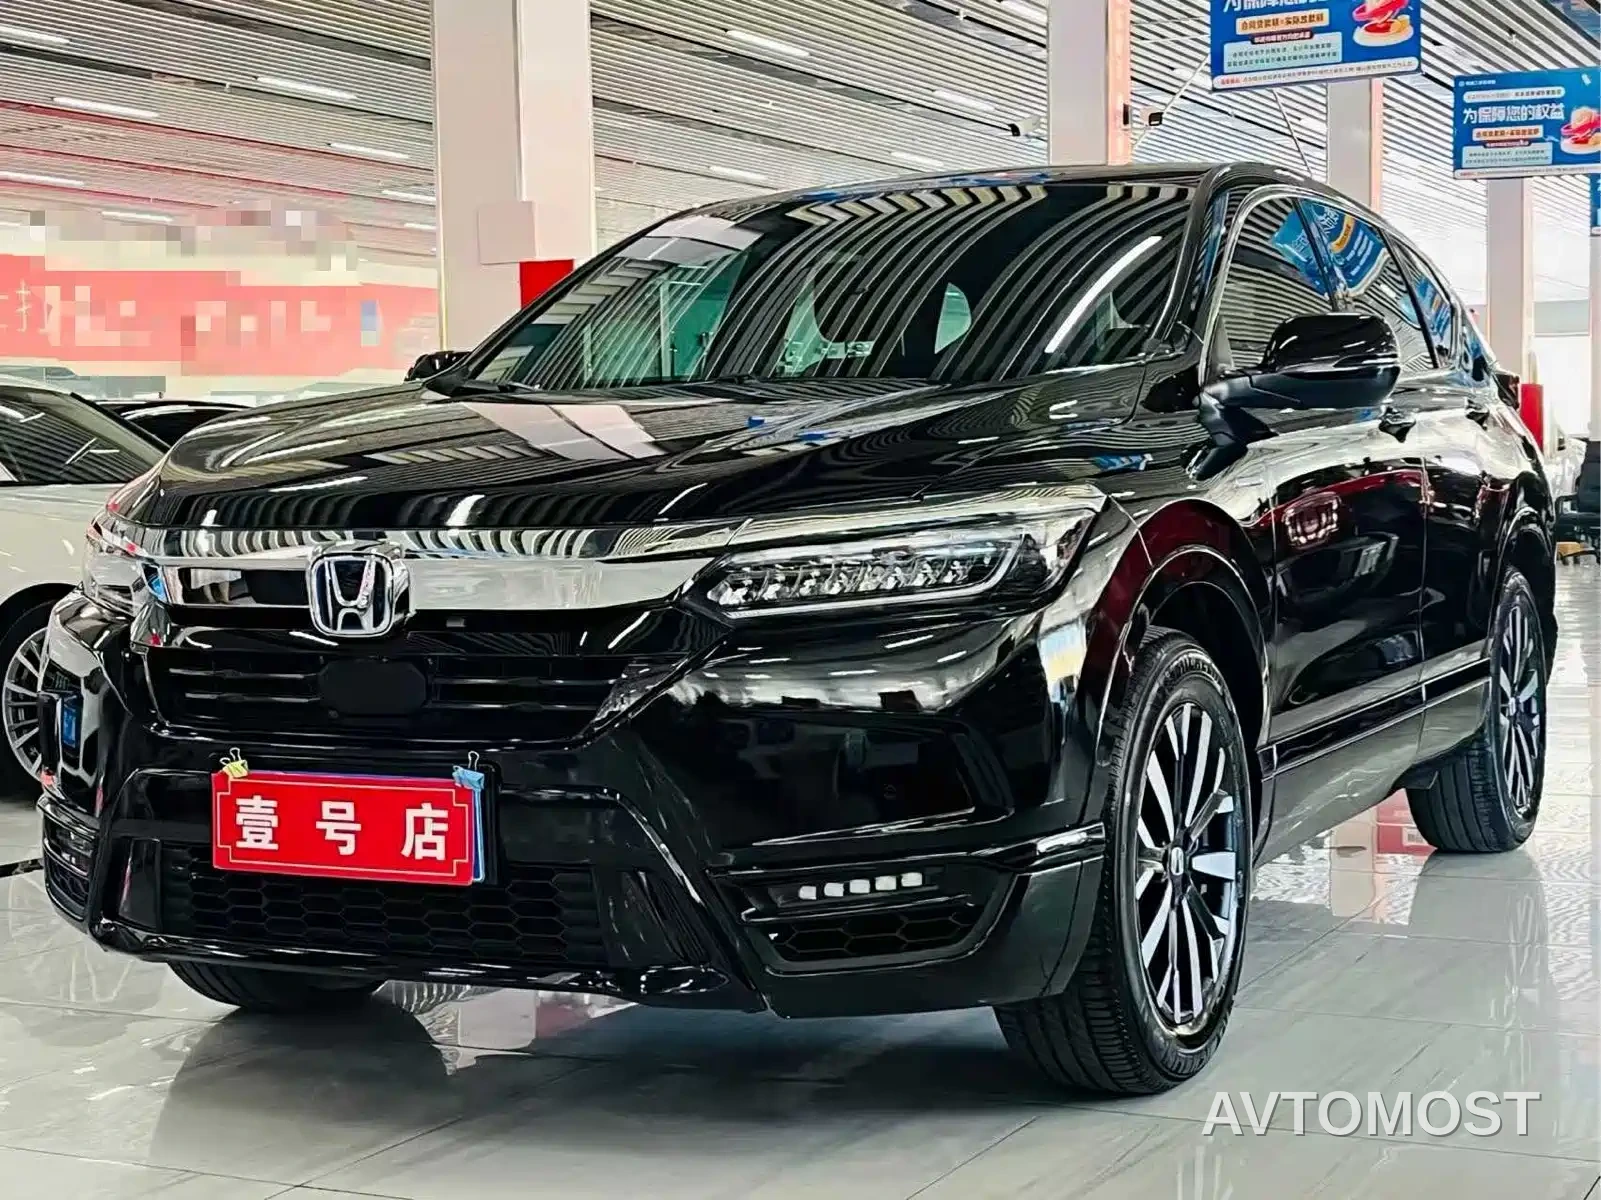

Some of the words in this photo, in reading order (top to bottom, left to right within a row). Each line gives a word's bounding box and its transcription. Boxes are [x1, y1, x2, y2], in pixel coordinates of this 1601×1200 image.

[1463, 103, 1565, 125] 为保障您的权益
[234, 795, 450, 861] 壹号店
